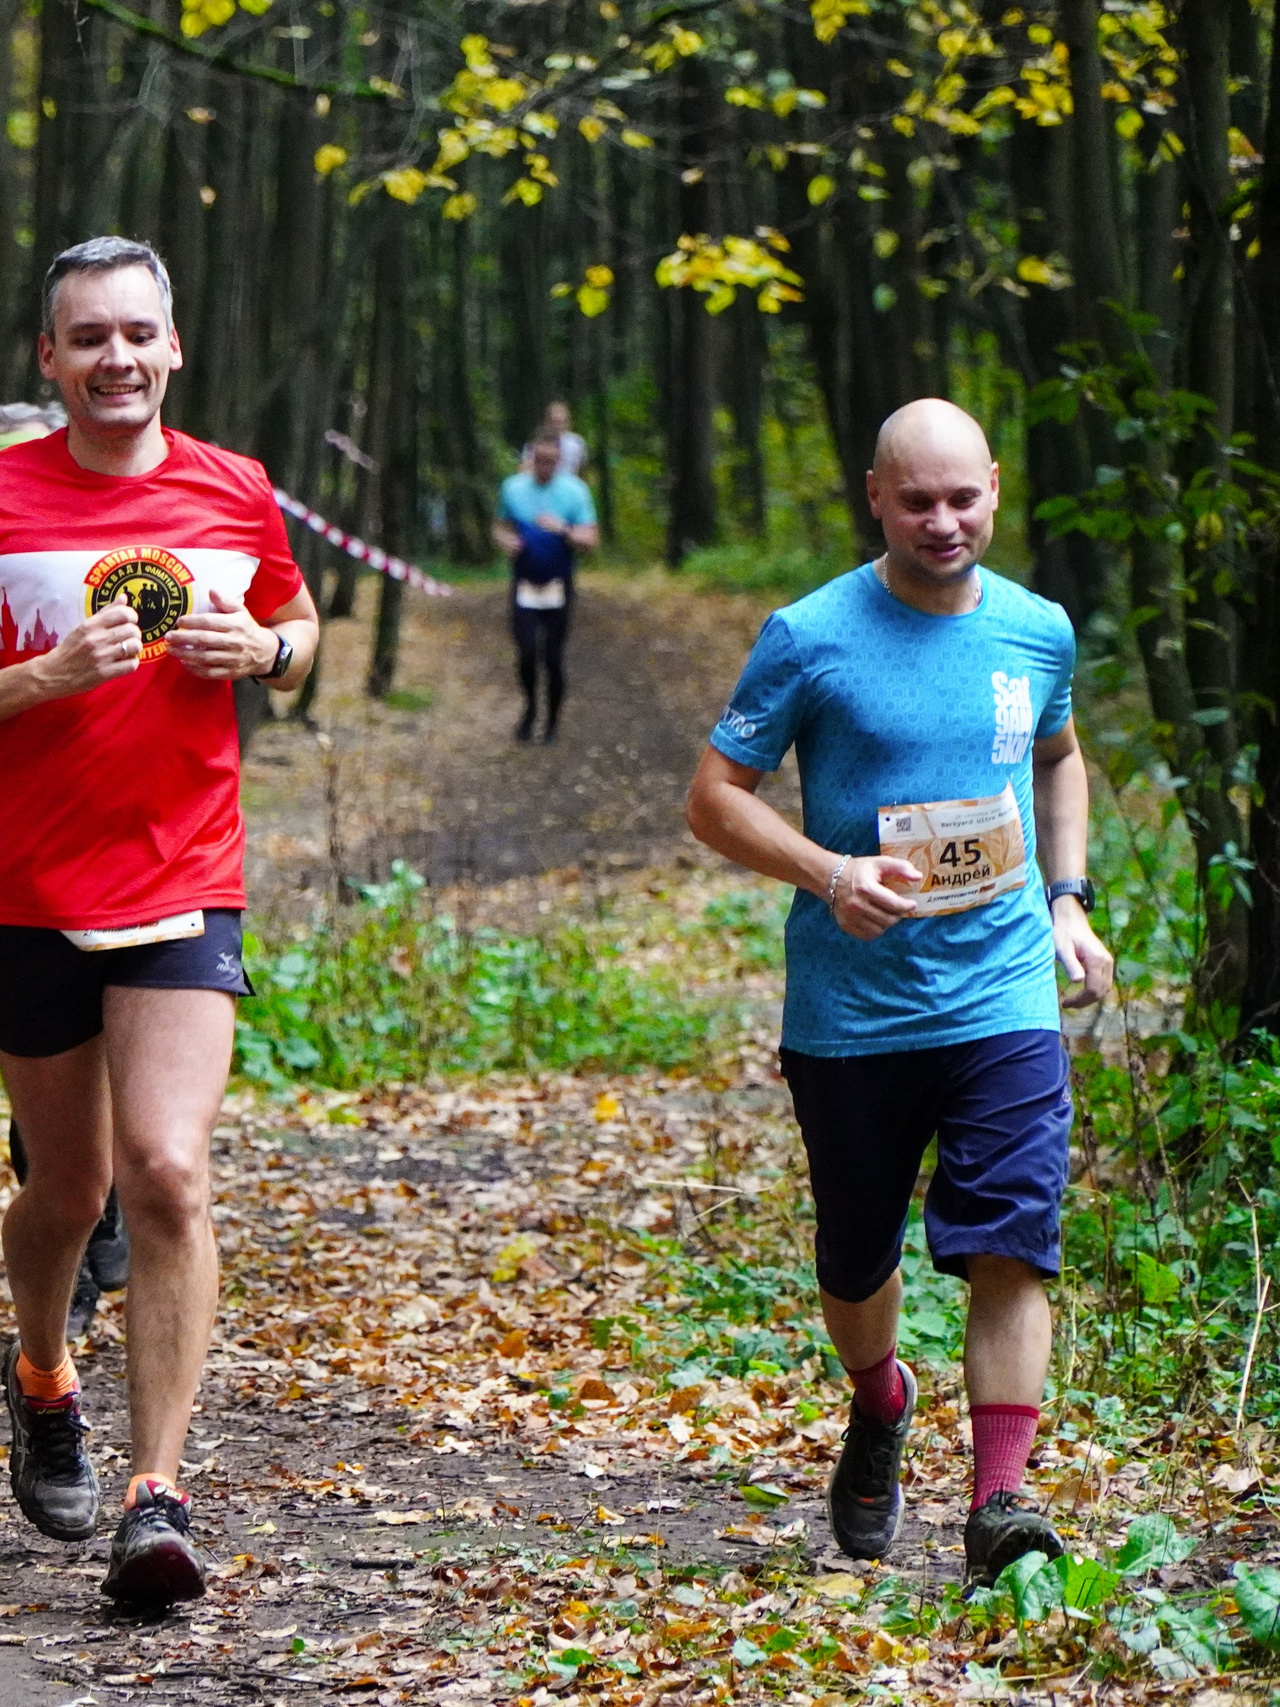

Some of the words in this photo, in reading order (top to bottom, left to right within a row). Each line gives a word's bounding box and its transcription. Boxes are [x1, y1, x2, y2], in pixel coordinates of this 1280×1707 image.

[89, 548, 138, 585] SPARTAK
[140, 547, 191, 583] MOSCOW
[101, 564, 134, 596] СКВАД
[146, 609, 178, 641] SQUAD
[939, 838, 982, 868] 45
[930, 864, 991, 888] Андрей
